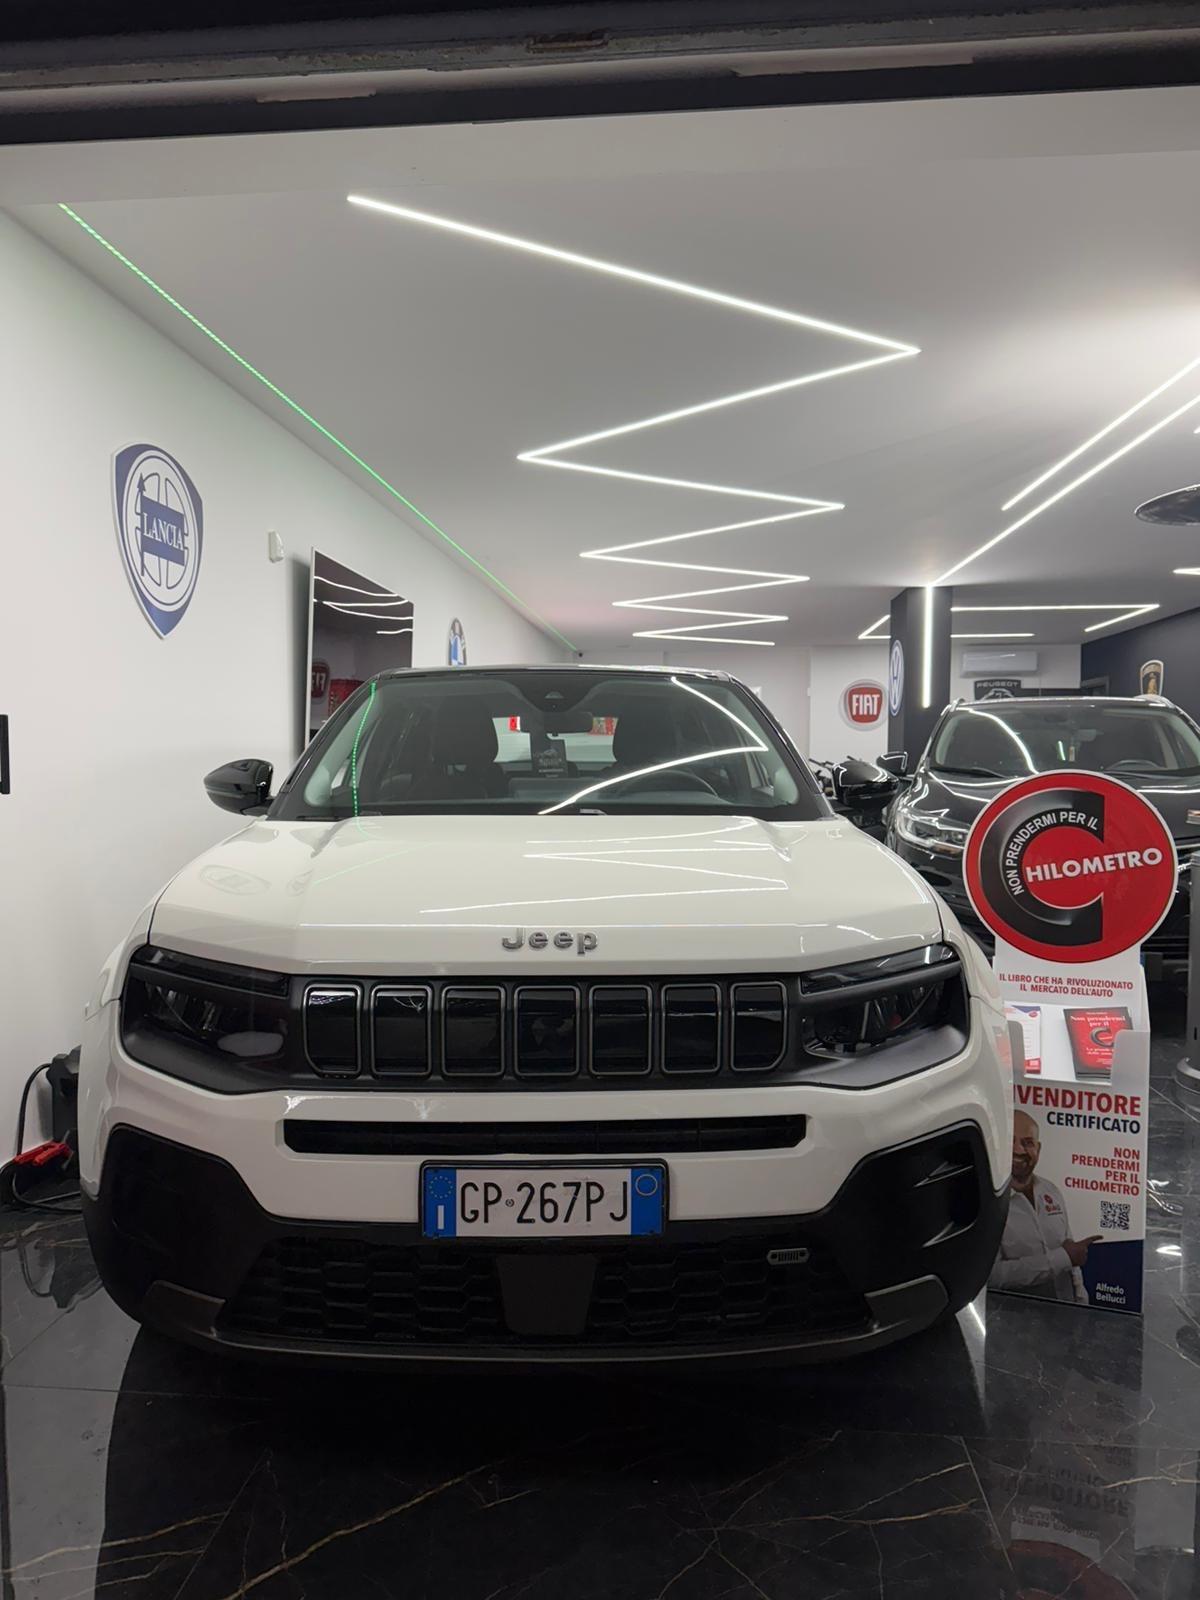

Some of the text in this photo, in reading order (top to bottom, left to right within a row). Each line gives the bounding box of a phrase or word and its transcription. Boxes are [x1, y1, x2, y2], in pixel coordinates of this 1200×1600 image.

[143, 512, 184, 551] LANCIA
[852, 694, 880, 716] FIAT
[1005, 811, 1098, 895] NON PRENDERMI PER IL
[502, 927, 598, 955] Jeep
[999, 973, 1134, 990] IL LIBRO CHE HA RIVOLUZIONATO
[1030, 984, 1069, 995] MERCATO
[1071, 986, 1114, 998] DELL'AUTO
[1013, 1084, 1142, 1116] IVENDITORE
[1046, 1111, 1141, 1134] CERTIFICATO
[1114, 1147, 1140, 1160] NON
[1071, 1154, 1140, 1172] PRENDERMI
[1105, 1170, 1140, 1184] PER IL
[1064, 1177, 1140, 1196] CHILOMETRO
[1096, 1283, 1125, 1295] Alfredo
[1096, 1293, 1126, 1304] Bellucci
